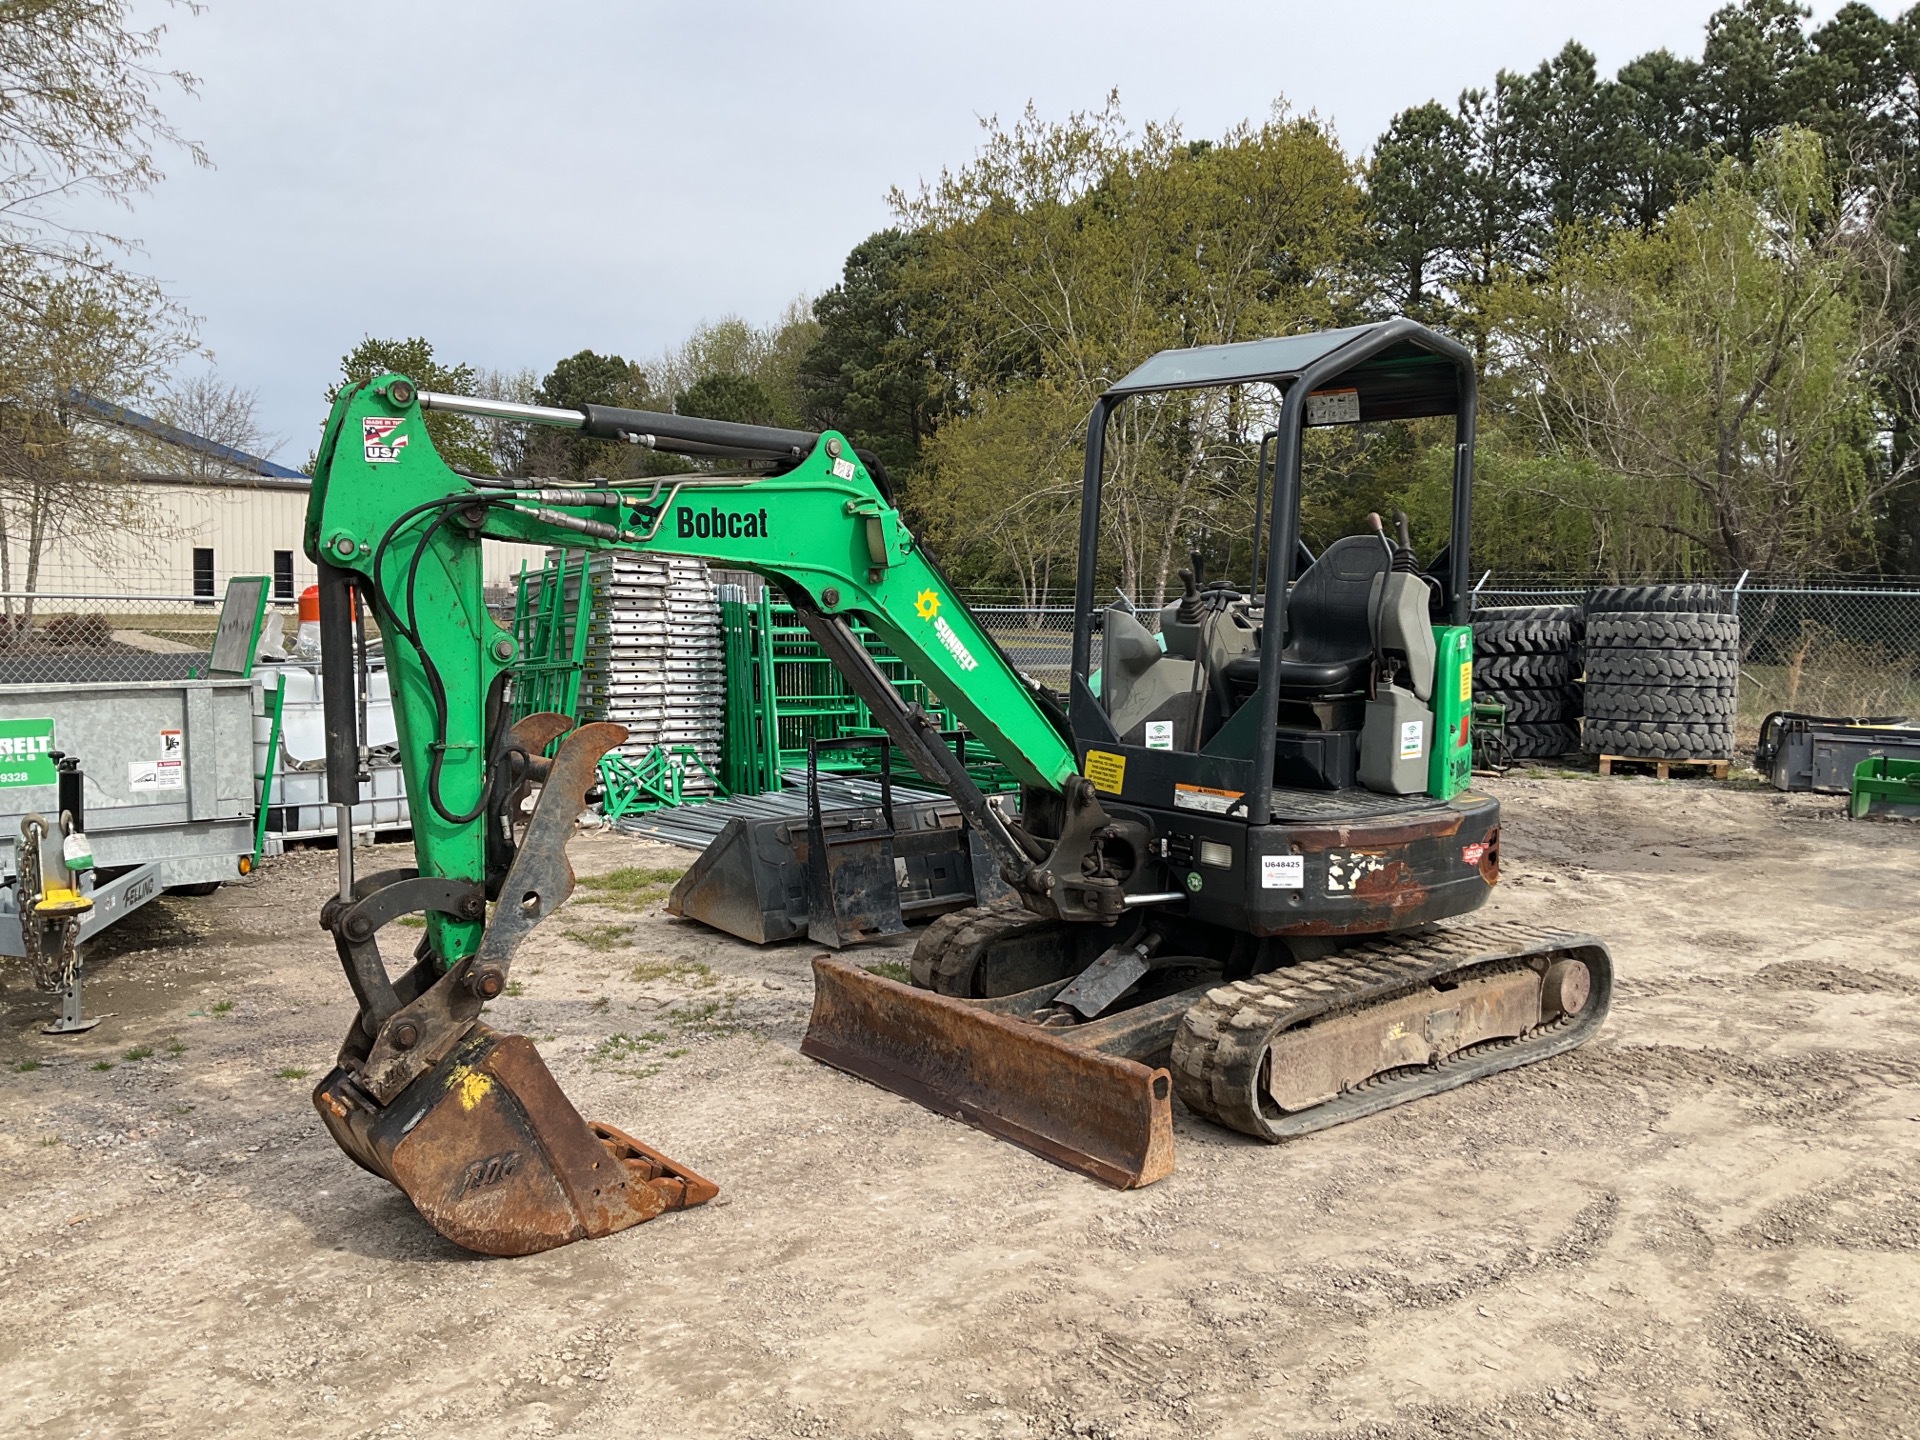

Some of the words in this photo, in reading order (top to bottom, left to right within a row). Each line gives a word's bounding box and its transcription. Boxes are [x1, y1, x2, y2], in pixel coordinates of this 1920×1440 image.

[677, 507, 768, 538] Bobcat
[934, 616, 979, 672] SUNBELT
[935, 631, 966, 671] RENTALS
[0, 772, 28, 782] 9328
[123, 873, 154, 908] FELLING
